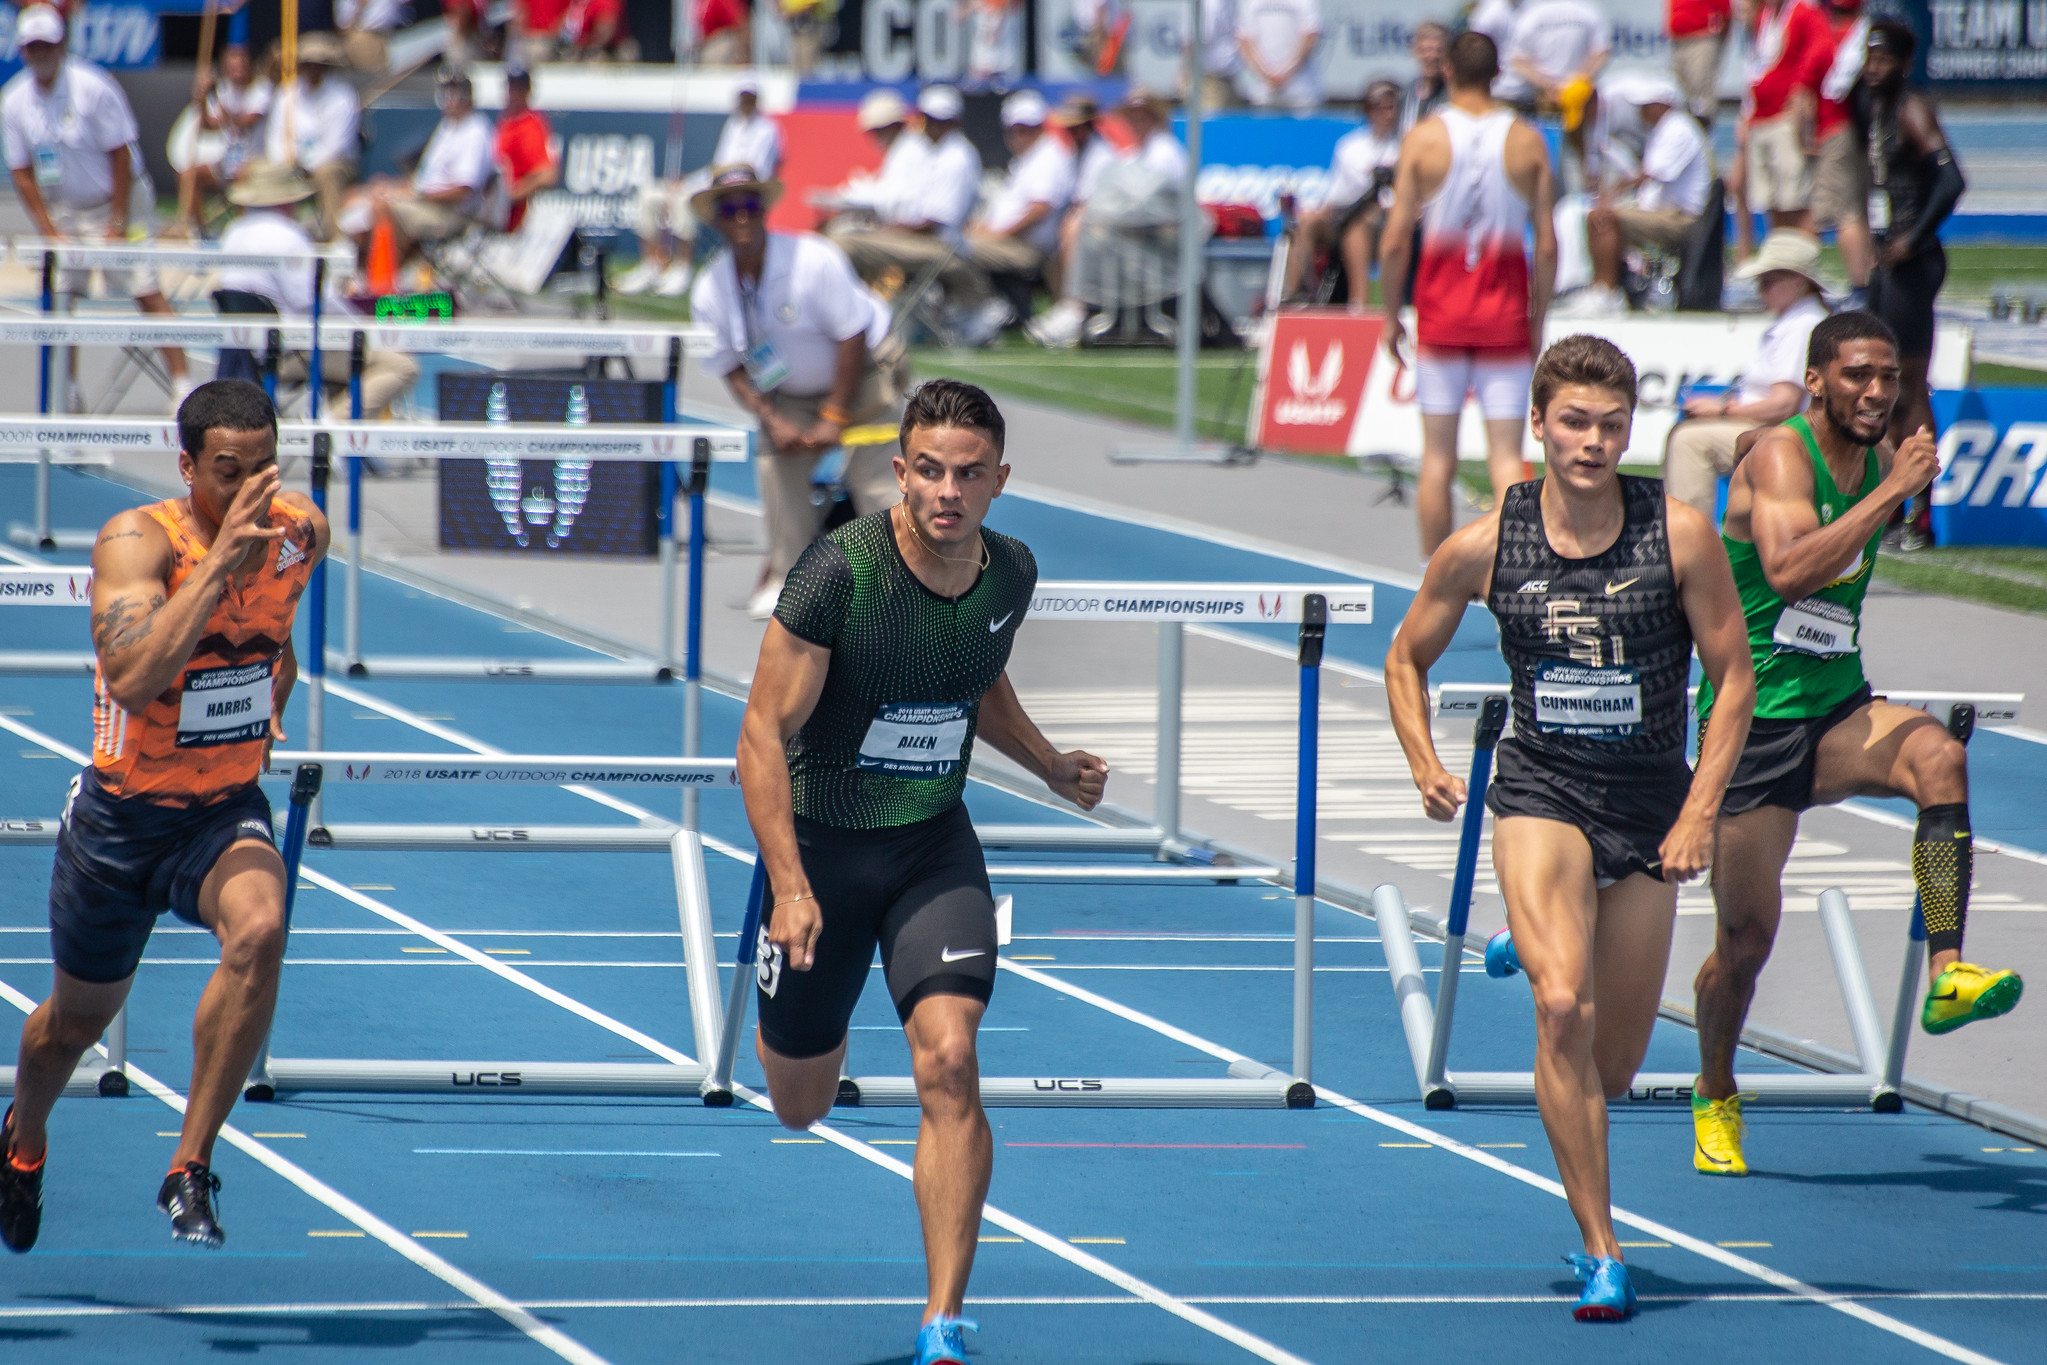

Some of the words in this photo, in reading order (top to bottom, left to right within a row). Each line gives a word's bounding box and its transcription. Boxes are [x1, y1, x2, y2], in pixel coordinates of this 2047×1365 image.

[564, 133, 655, 194] USA
[37, 432, 152, 445] CHAMPIONSHIPS
[527, 442, 642, 454] CHAMPIONSHIPS
[277, 552, 304, 572] adidas
[1517, 580, 1550, 593] ACC
[1103, 598, 1245, 614] CHAMPIONSHIPS
[1328, 603, 1367, 612] UCS
[191, 667, 269, 690] CHAMPIONSHIPS
[1543, 670, 1633, 684] CHAMPIONSHIPS
[206, 697, 252, 718] HARRIS
[1440, 702, 1478, 710] UCS
[1541, 696, 1634, 713] CUNNINGHAM
[883, 709, 963, 723] CHAMPIONSHIPS
[1977, 710, 2016, 719] UCS
[897, 736, 938, 750] ALLEN
[384, 769, 421, 779] 2018
[425, 769, 482, 780] USATF
[485, 770, 567, 781] OUTDOOR
[571, 771, 715, 784] CHAMPIONSHIPS
[472, 829, 529, 841] UCS
[453, 1072, 522, 1086] UCS
[1034, 1079, 1102, 1091] UCS
